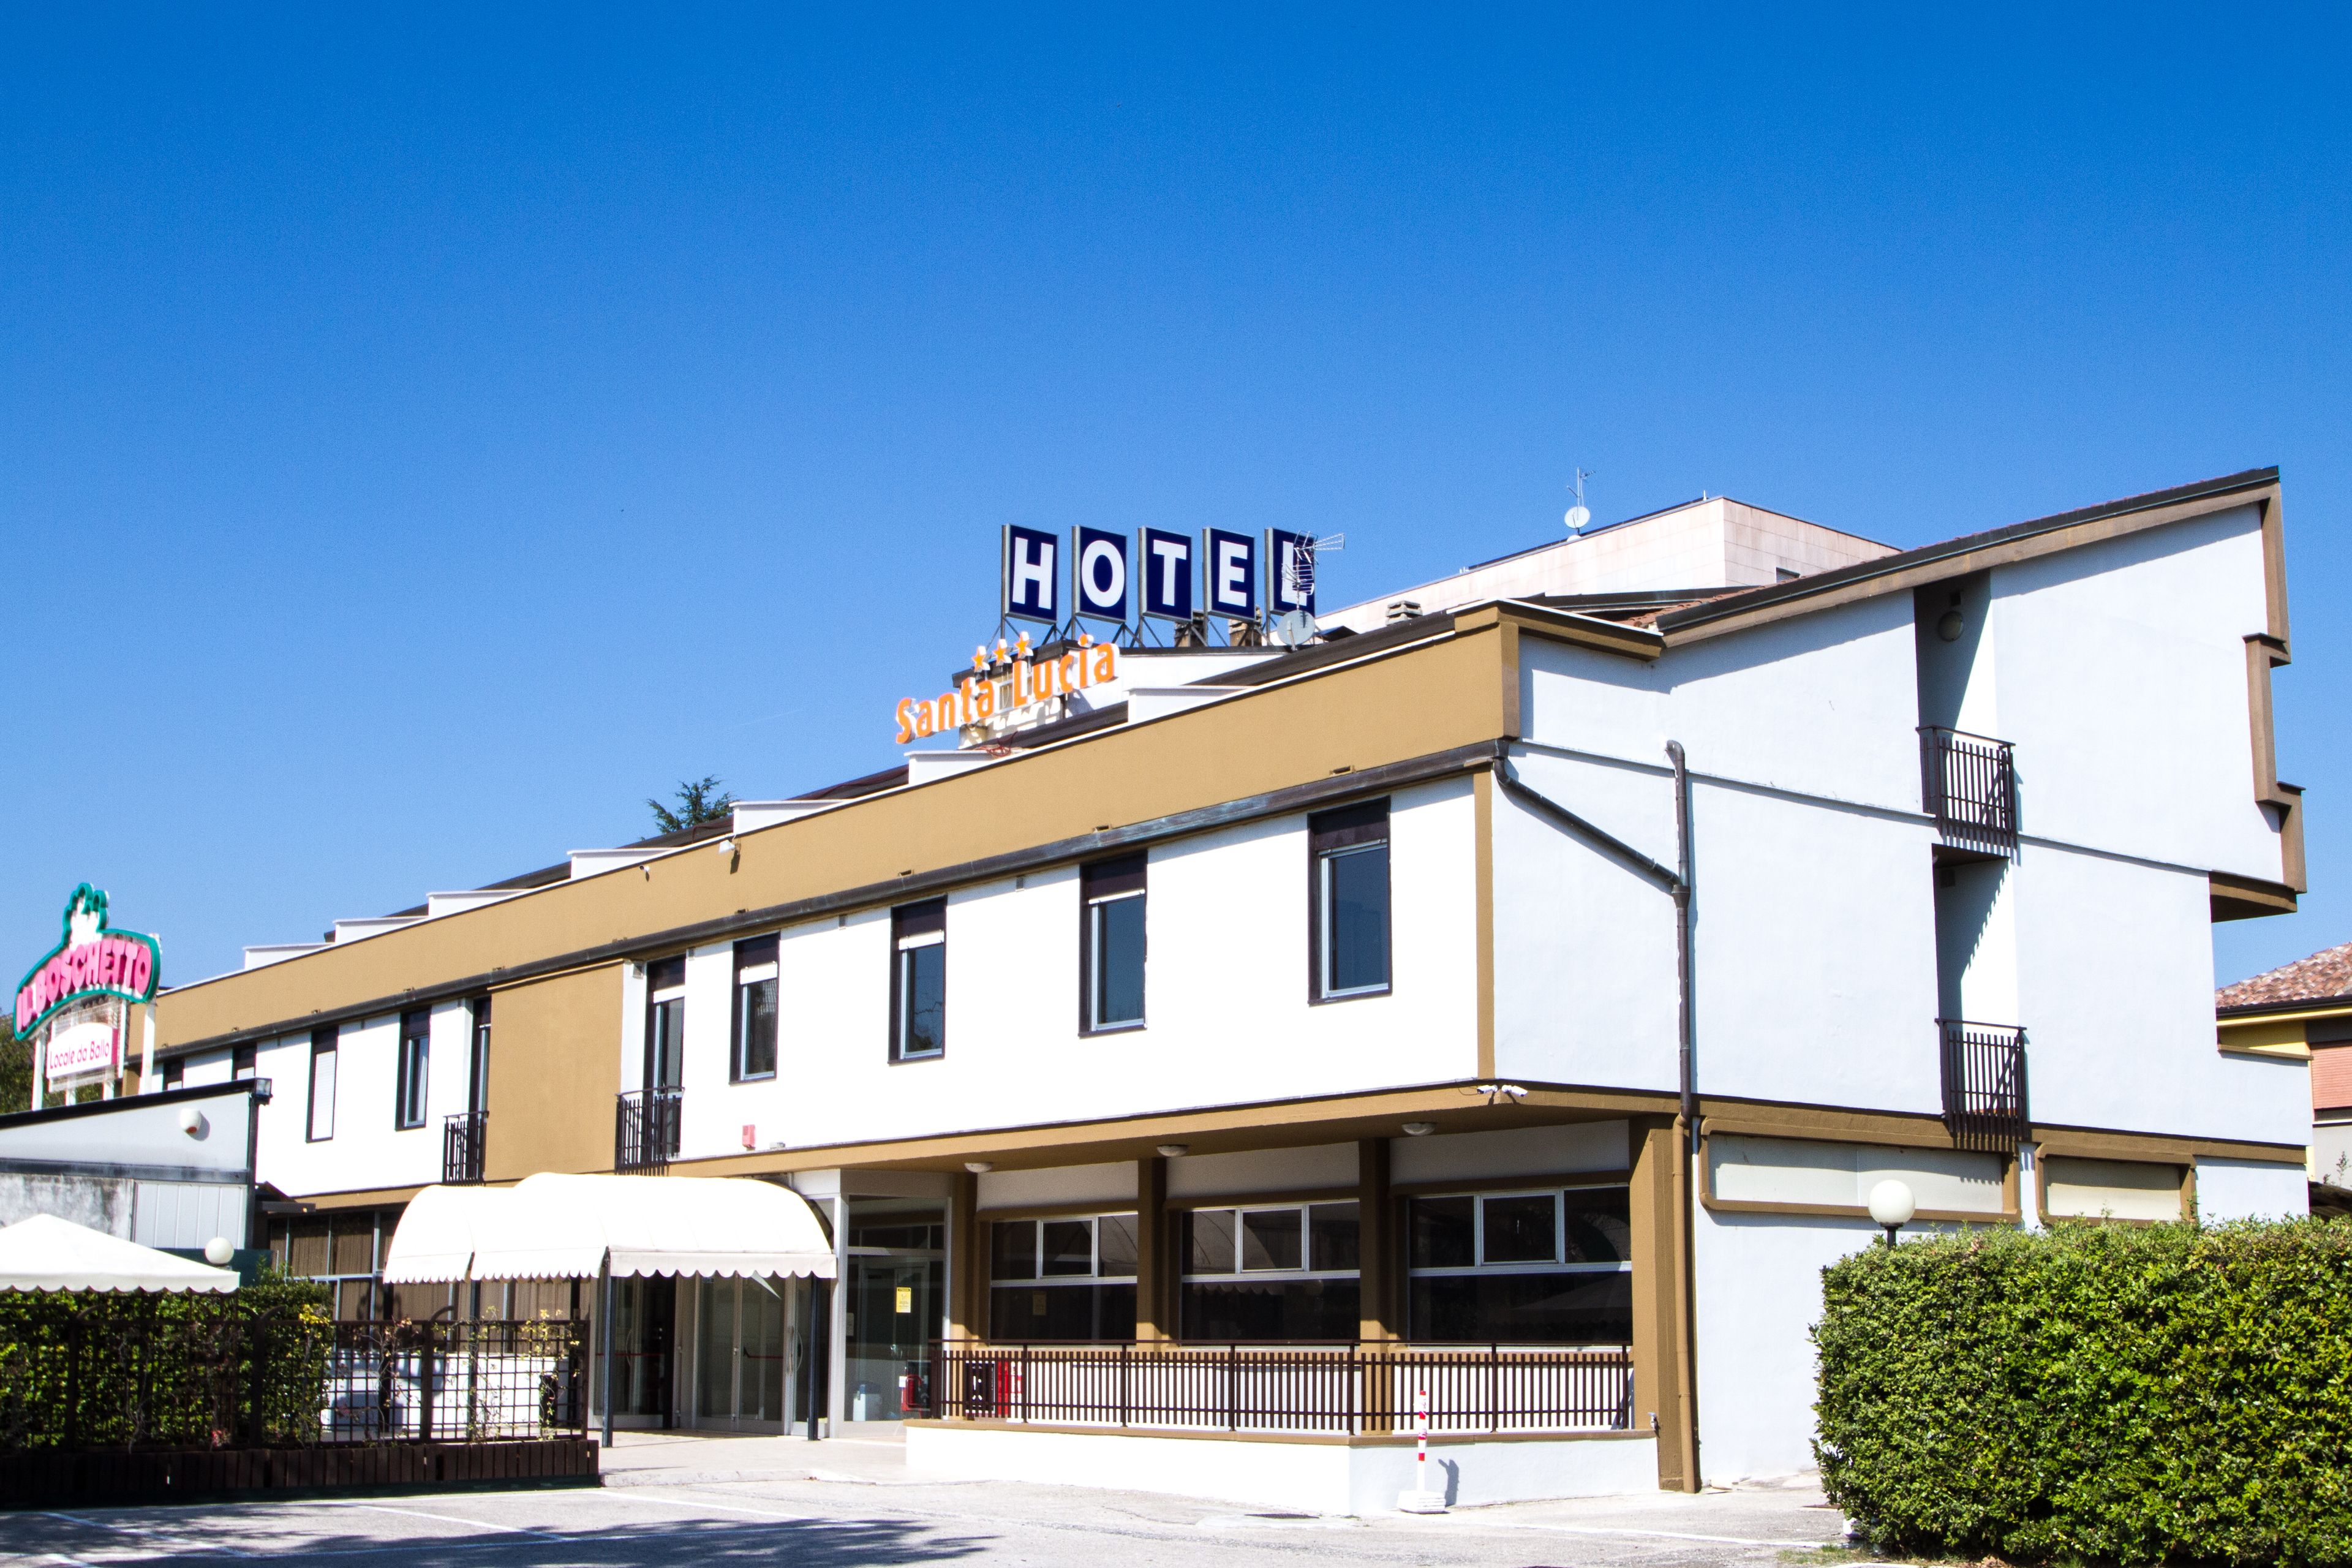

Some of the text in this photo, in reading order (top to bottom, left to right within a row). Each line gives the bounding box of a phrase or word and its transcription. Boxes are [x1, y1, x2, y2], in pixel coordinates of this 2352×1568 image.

[1012, 537, 1307, 609] HOTEL
[896, 633, 1115, 744] Santa Lucia
[16, 938, 153, 1033] IL BOSCHETTO
[49, 1039, 110, 1069] Locale da Ballo
